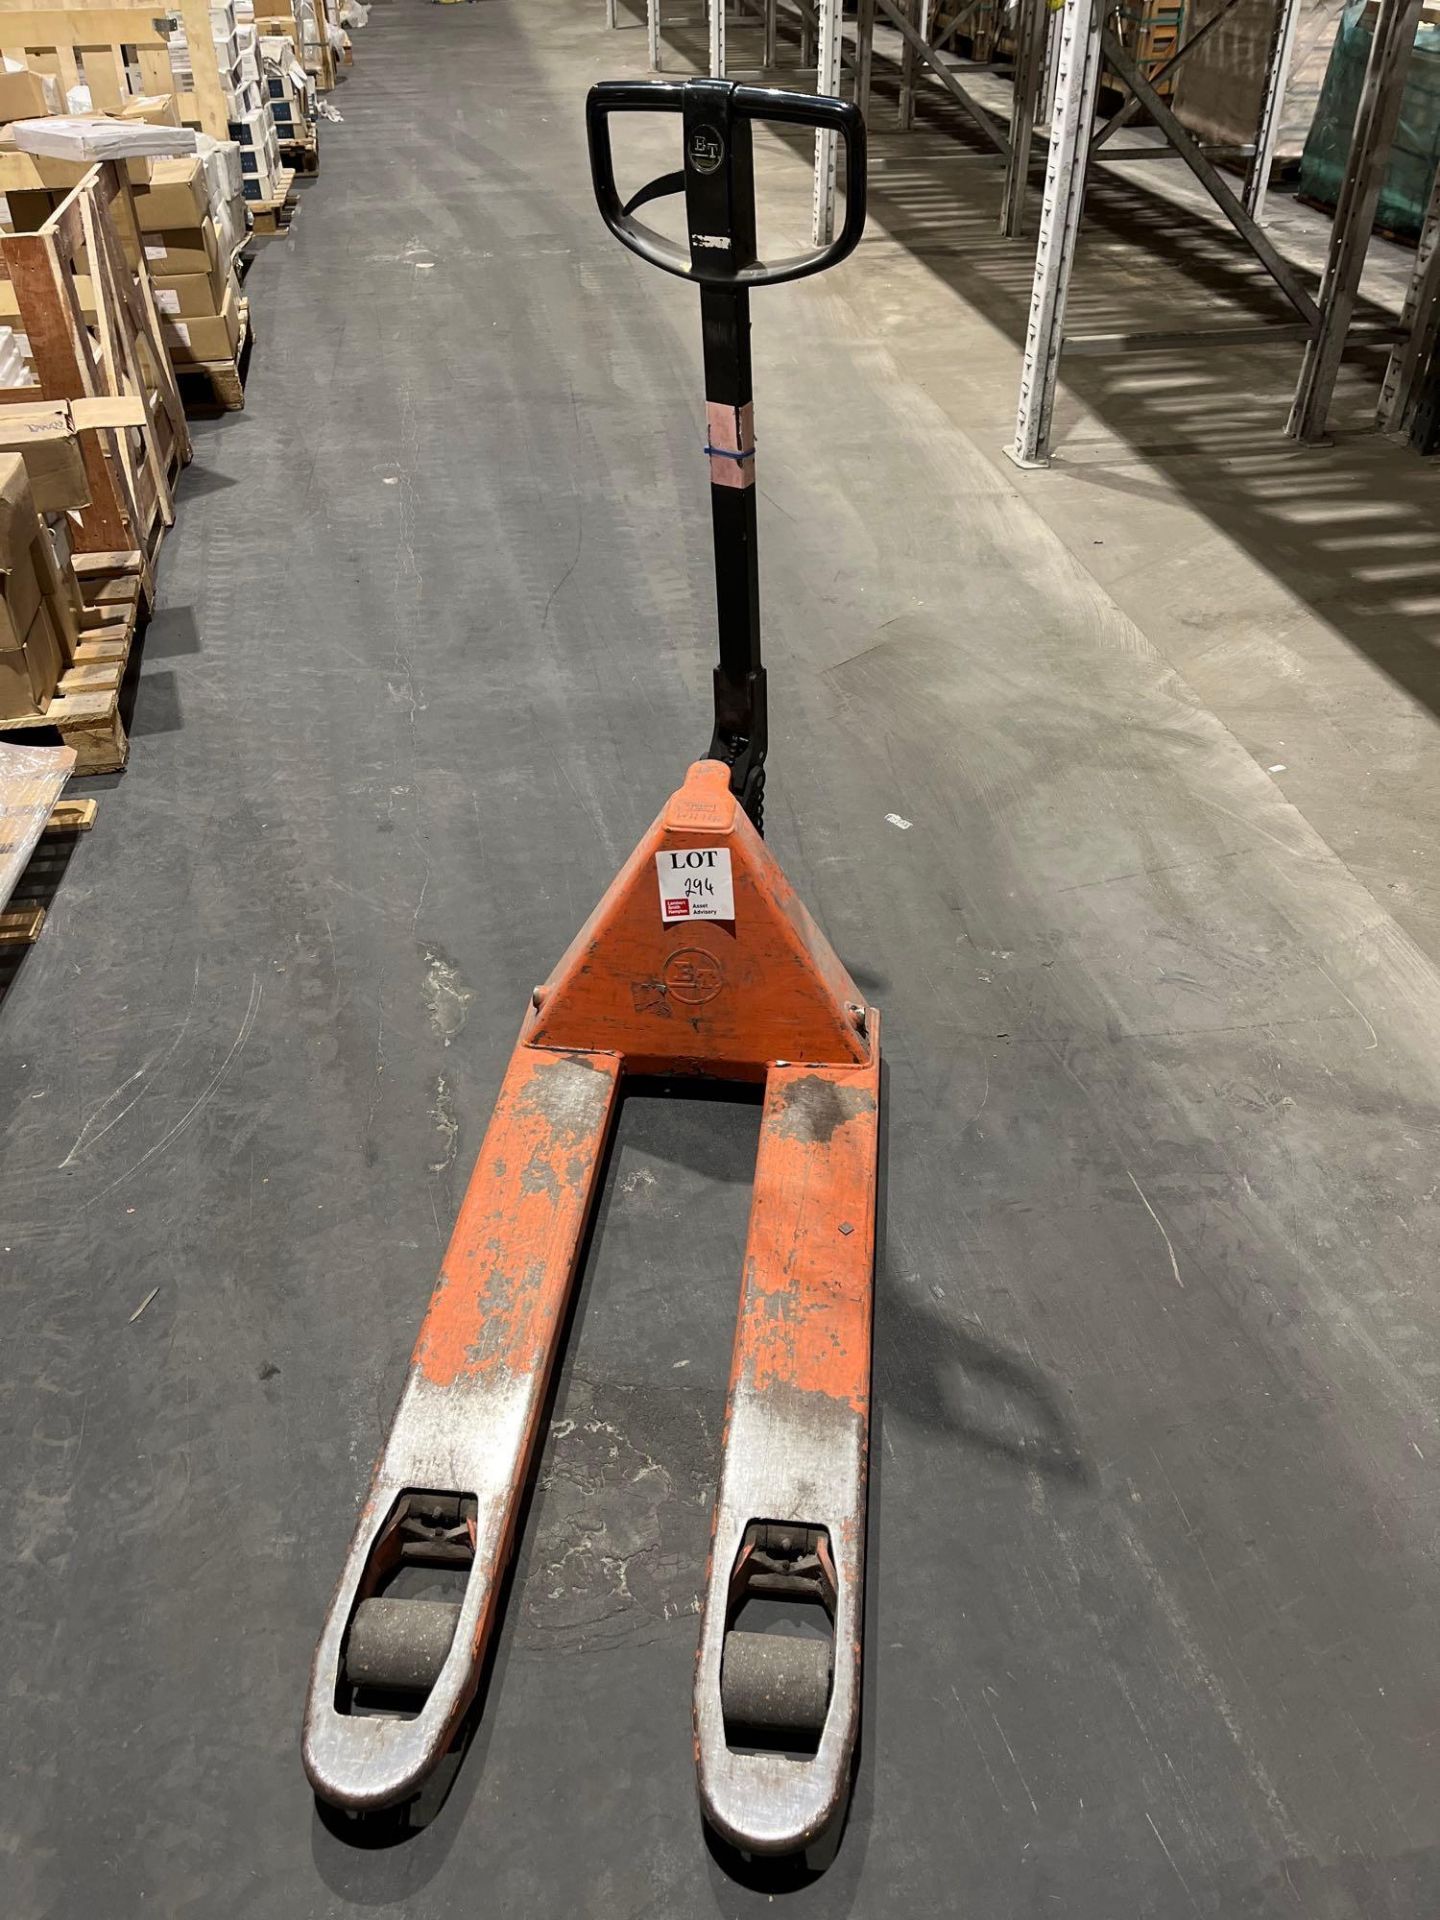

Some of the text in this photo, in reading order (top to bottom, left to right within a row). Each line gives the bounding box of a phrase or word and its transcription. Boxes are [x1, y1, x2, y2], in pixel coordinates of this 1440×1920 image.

[694, 136, 718, 158] BT
[670, 851, 718, 869] LOT
[684, 877, 714, 897] 294
